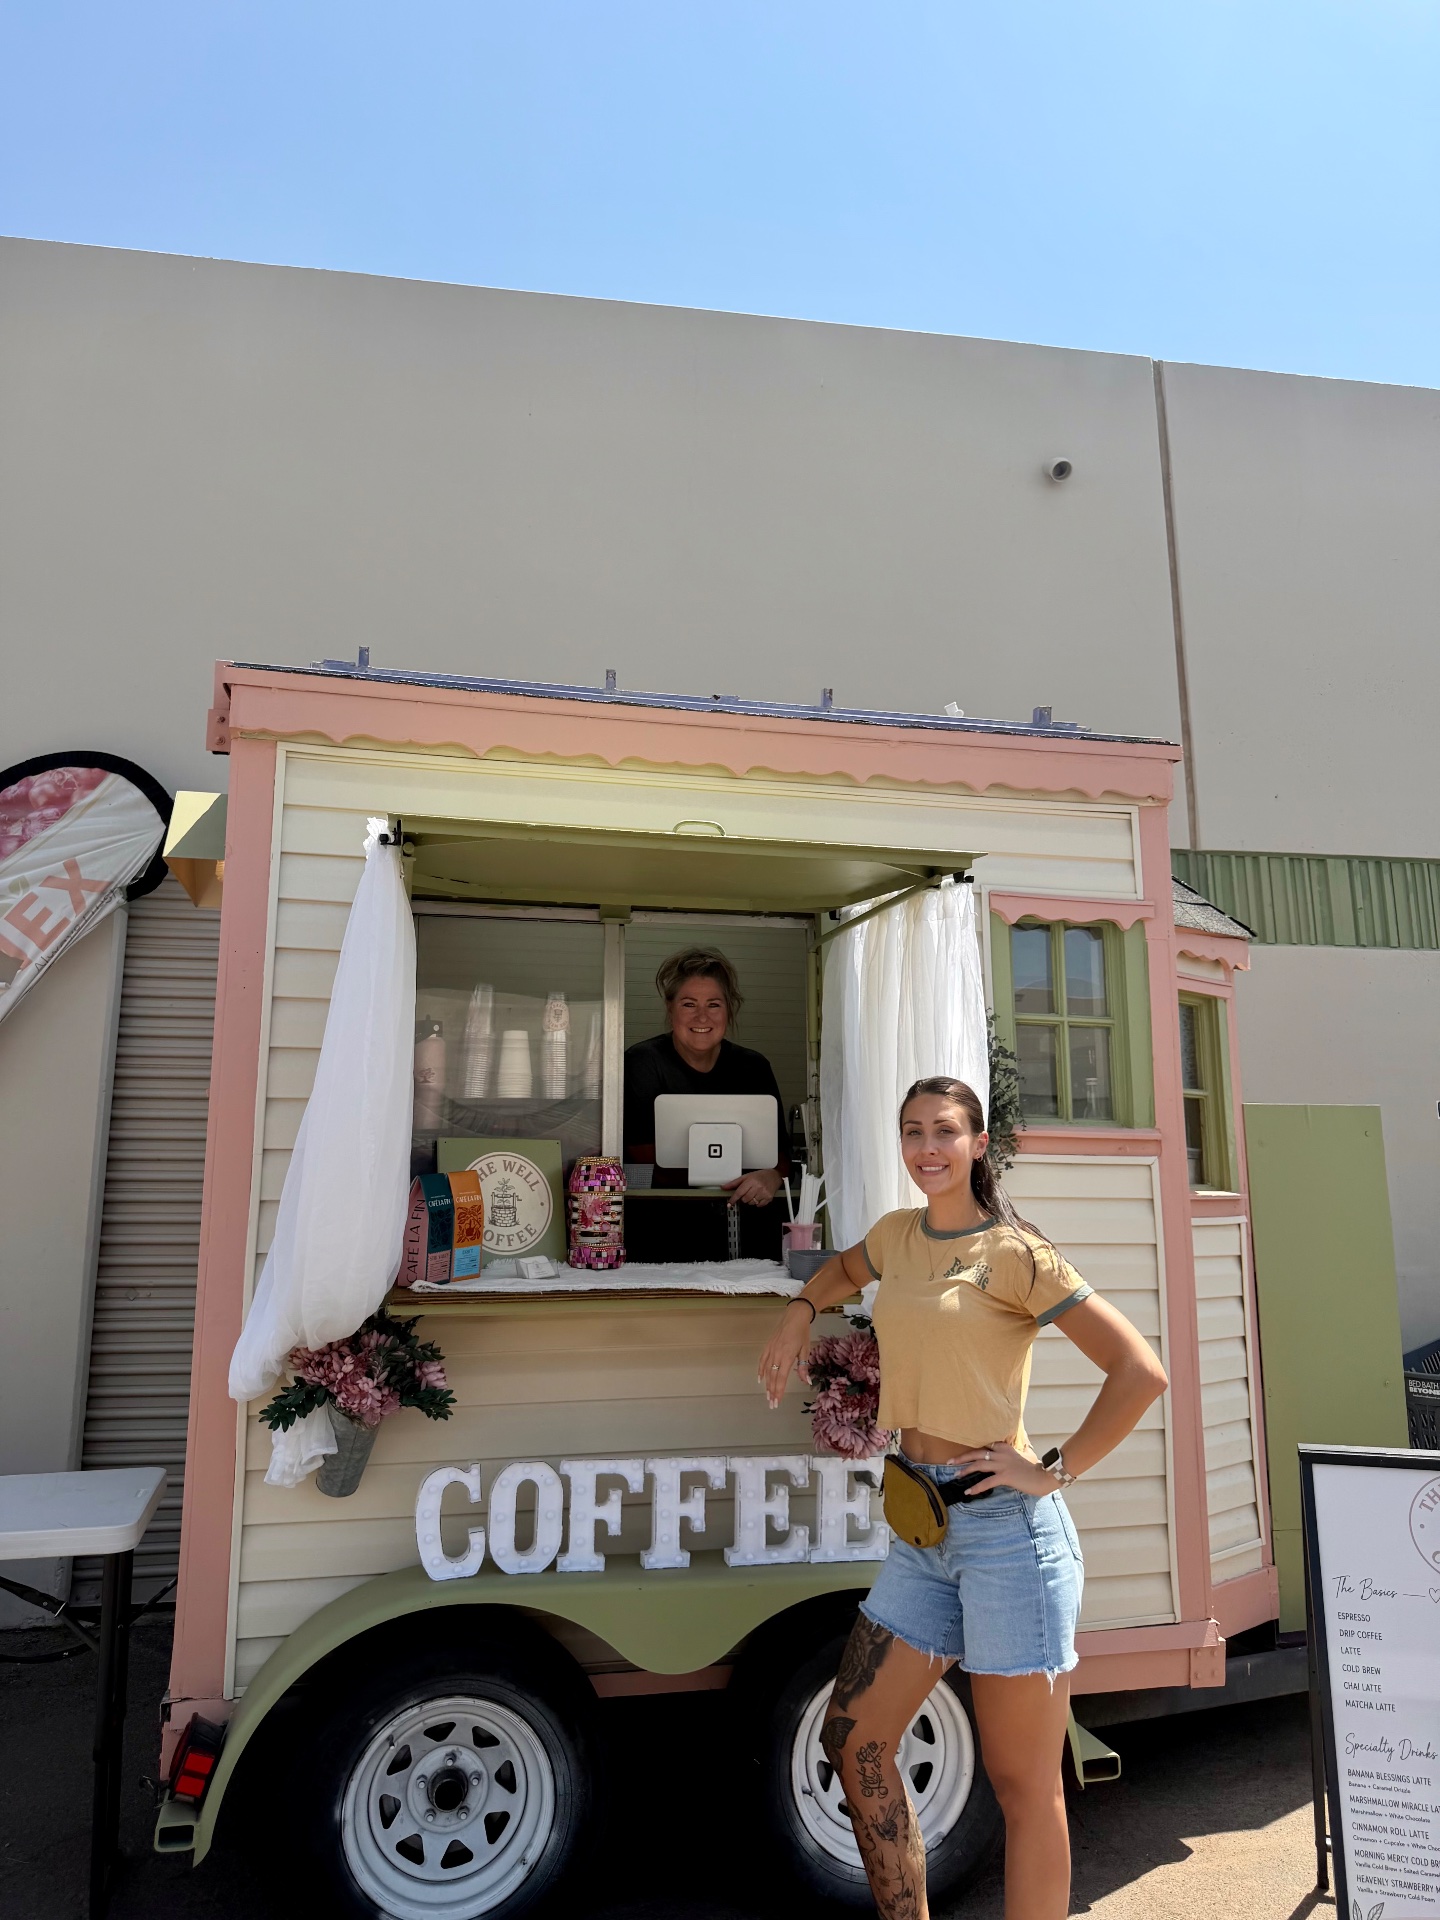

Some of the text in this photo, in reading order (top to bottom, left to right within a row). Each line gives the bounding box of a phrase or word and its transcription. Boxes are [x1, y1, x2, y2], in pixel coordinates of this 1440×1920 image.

[478, 1160, 540, 1192] HE WELL
[411, 1199, 426, 1220] FIN
[409, 1225, 421, 1242] LA
[483, 1223, 537, 1247] OFFEE
[1409, 1380, 1421, 1388] BED
[1422, 1381, 1439, 1389] BATH
[1419, 1484, 1440, 1512] TH
[414, 1453, 890, 1582] COFFEE
[1332, 1575, 1398, 1600] The Basics
[1338, 1612, 1370, 1622] ESPRESSO
[1340, 1629, 1382, 1640] DRIP COFFEE
[1340, 1646, 1362, 1656] LATTE
[1342, 1664, 1381, 1675] COLD BREW
[1344, 1682, 1382, 1693] CHAI LATTE
[1345, 1699, 1396, 1712] MATCHA LATTE
[1345, 1732, 1438, 1762] Specialty Drinks
[1348, 1769, 1432, 1786] BANANA BLESSINGS LATTE
[1350, 1795, 1399, 1808] MARSHMALLOW
[1402, 1802, 1429, 1812] MIRACLE
[1351, 1808, 1382, 1817] Marshmallow
[1352, 1822, 1429, 1840] CINNAMON ROLL LATTE
[1353, 1835, 1377, 1843] Cinnamon
[1384, 1839, 1405, 1847] Cupcake
[1355, 1849, 1385, 1860] MORNING
[1387, 1854, 1408, 1864] MERCY
[1411, 1857, 1428, 1866] COLD
[1357, 1874, 1389, 1886] HEAVENLY
[1391, 1879, 1433, 1892] STRAWBERRY
[1357, 1886, 1373, 1894] Vanilla
[1380, 1890, 1406, 1899] Strawberry
